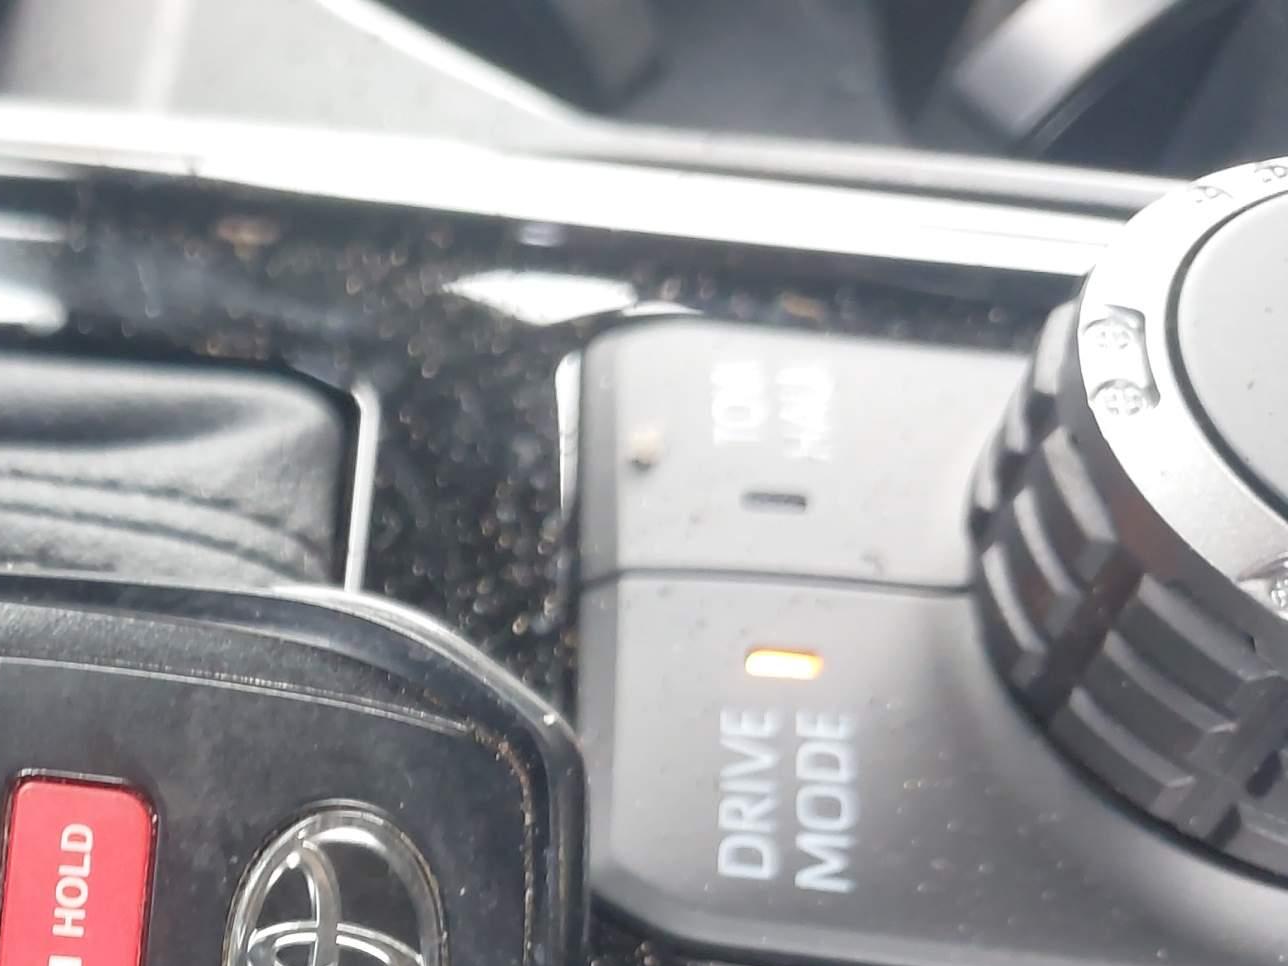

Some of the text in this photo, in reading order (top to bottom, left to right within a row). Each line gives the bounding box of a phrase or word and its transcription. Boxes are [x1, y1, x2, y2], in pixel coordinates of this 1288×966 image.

[52, 823, 93, 938] HOLD
[717, 708, 779, 881] DRIVE
[794, 709, 857, 894] MODE
